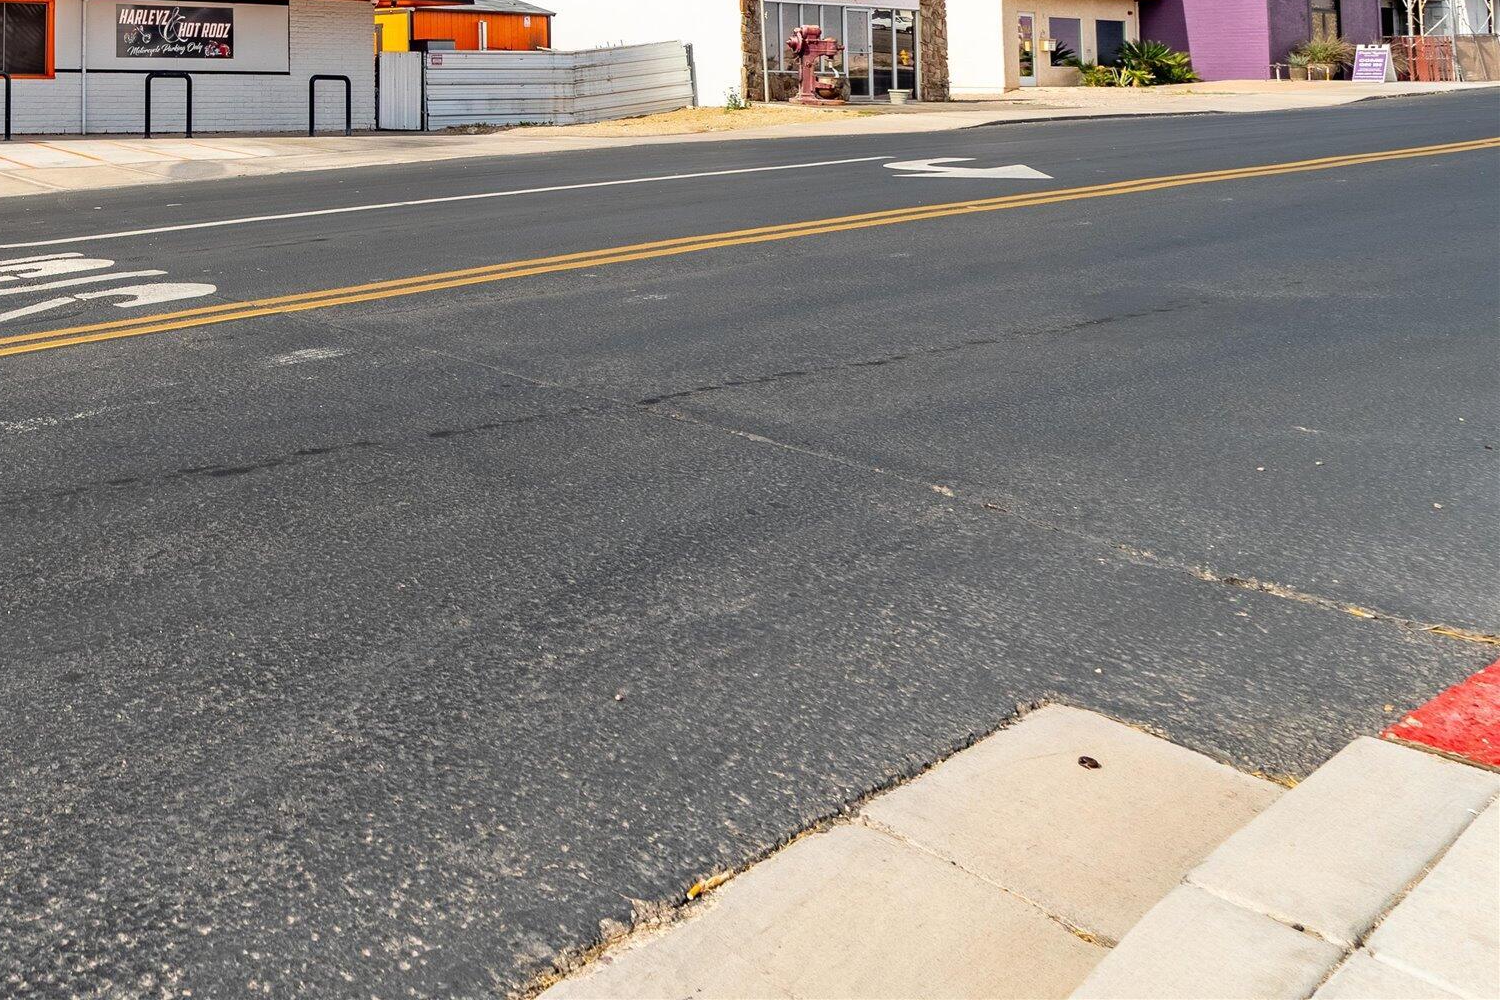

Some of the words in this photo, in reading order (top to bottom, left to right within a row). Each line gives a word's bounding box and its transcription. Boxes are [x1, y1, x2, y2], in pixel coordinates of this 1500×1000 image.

[119, 8, 170, 26] HARLEYZ
[178, 22, 201, 37] HOT
[201, 23, 231, 38] RODZ
